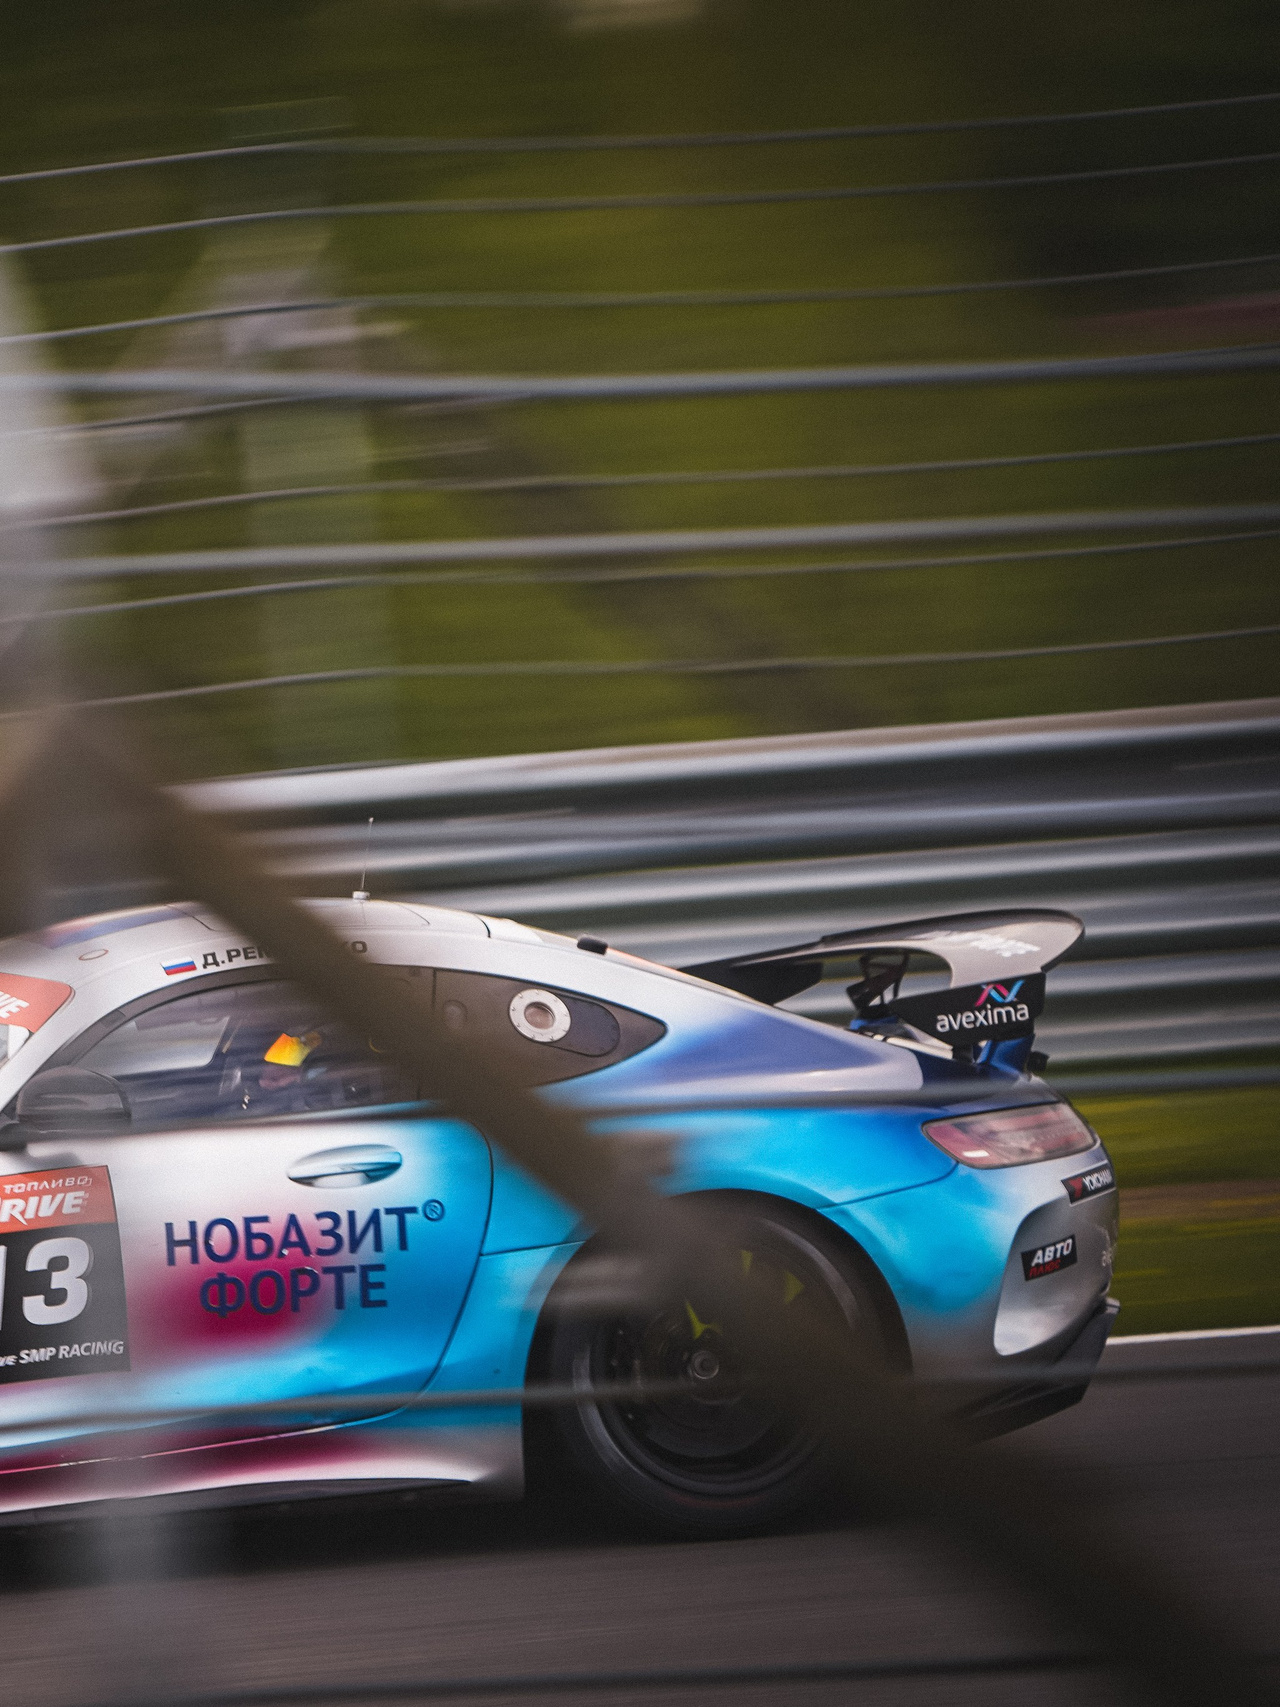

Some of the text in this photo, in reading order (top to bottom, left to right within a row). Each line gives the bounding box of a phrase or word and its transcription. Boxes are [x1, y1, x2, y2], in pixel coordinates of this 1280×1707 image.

[936, 1003, 1030, 1033] avexima
[3, 1176, 90, 1194] ТОПЛИВО
[1031, 1238, 1073, 1268] АВТО
[199, 1264, 388, 1319] ФОРТЕ
[19, 1347, 56, 1364] SMP
[58, 1340, 124, 1360] RACING
